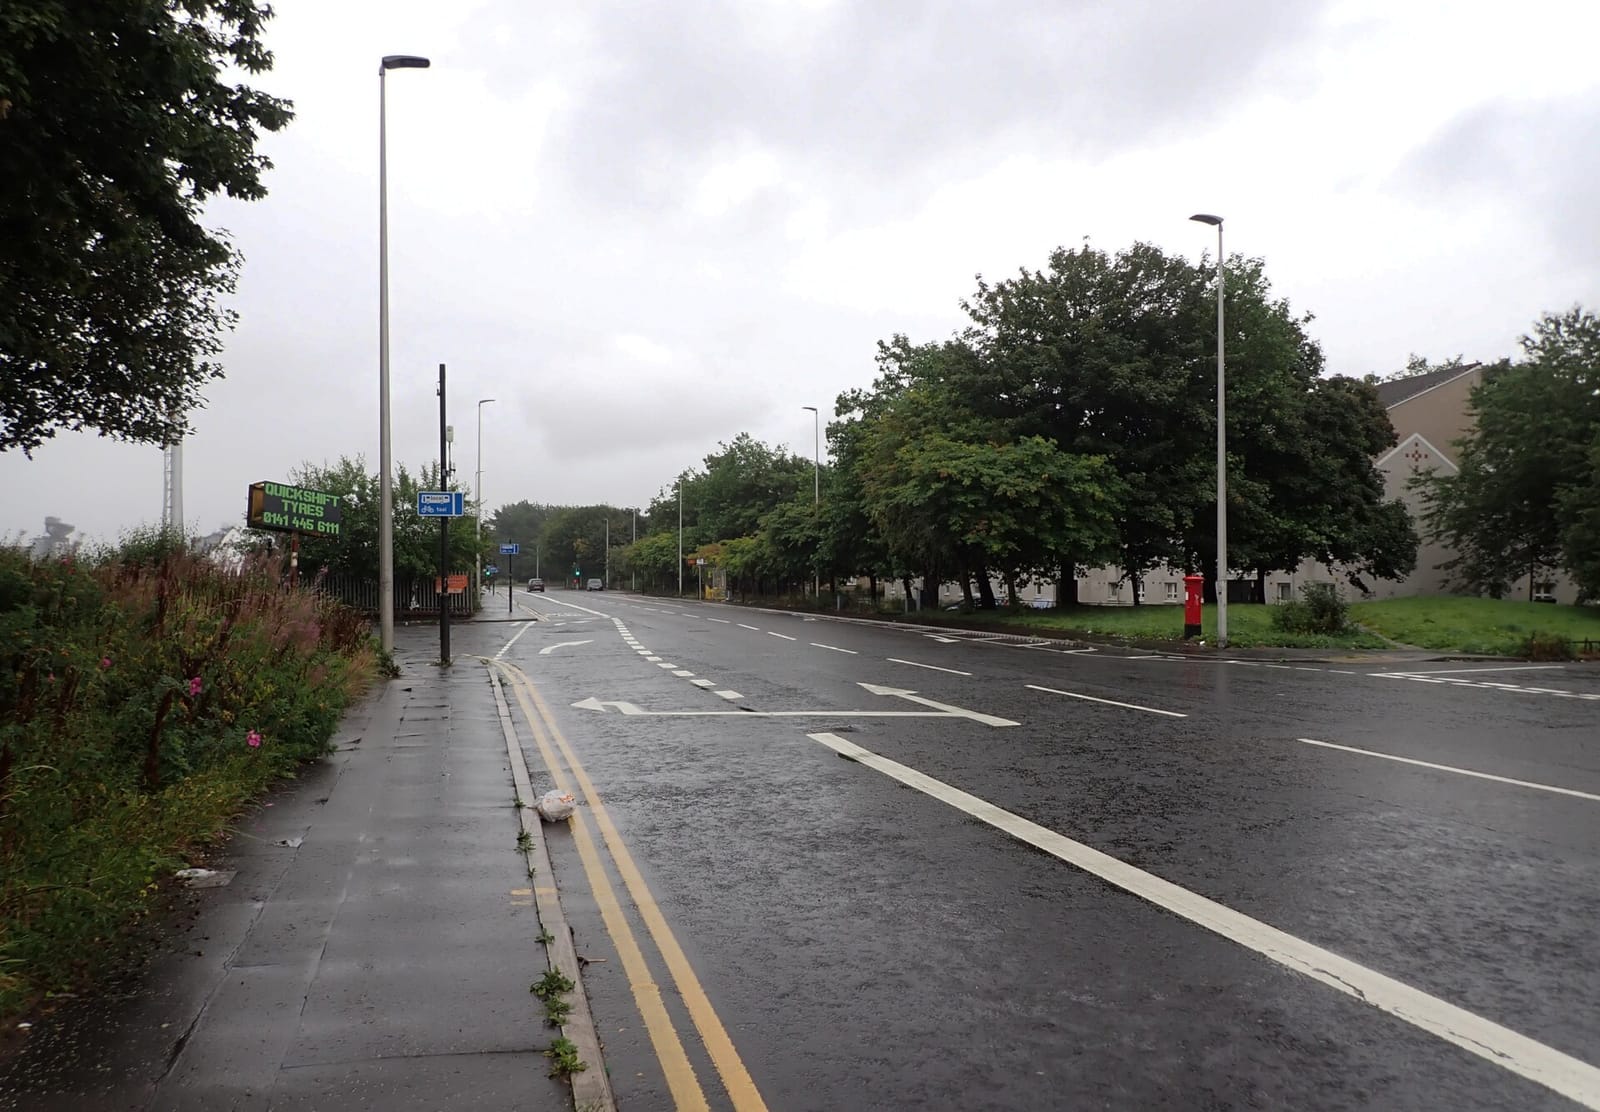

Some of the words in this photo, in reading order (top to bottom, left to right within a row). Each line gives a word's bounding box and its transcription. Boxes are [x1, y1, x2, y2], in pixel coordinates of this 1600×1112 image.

[265, 483, 340, 507] QUICKSHIFT
[281, 500, 324, 517] TYRES
[263, 512, 288, 526] 0141
[292, 516, 314, 530] 445
[317, 521, 339, 534] 6111
